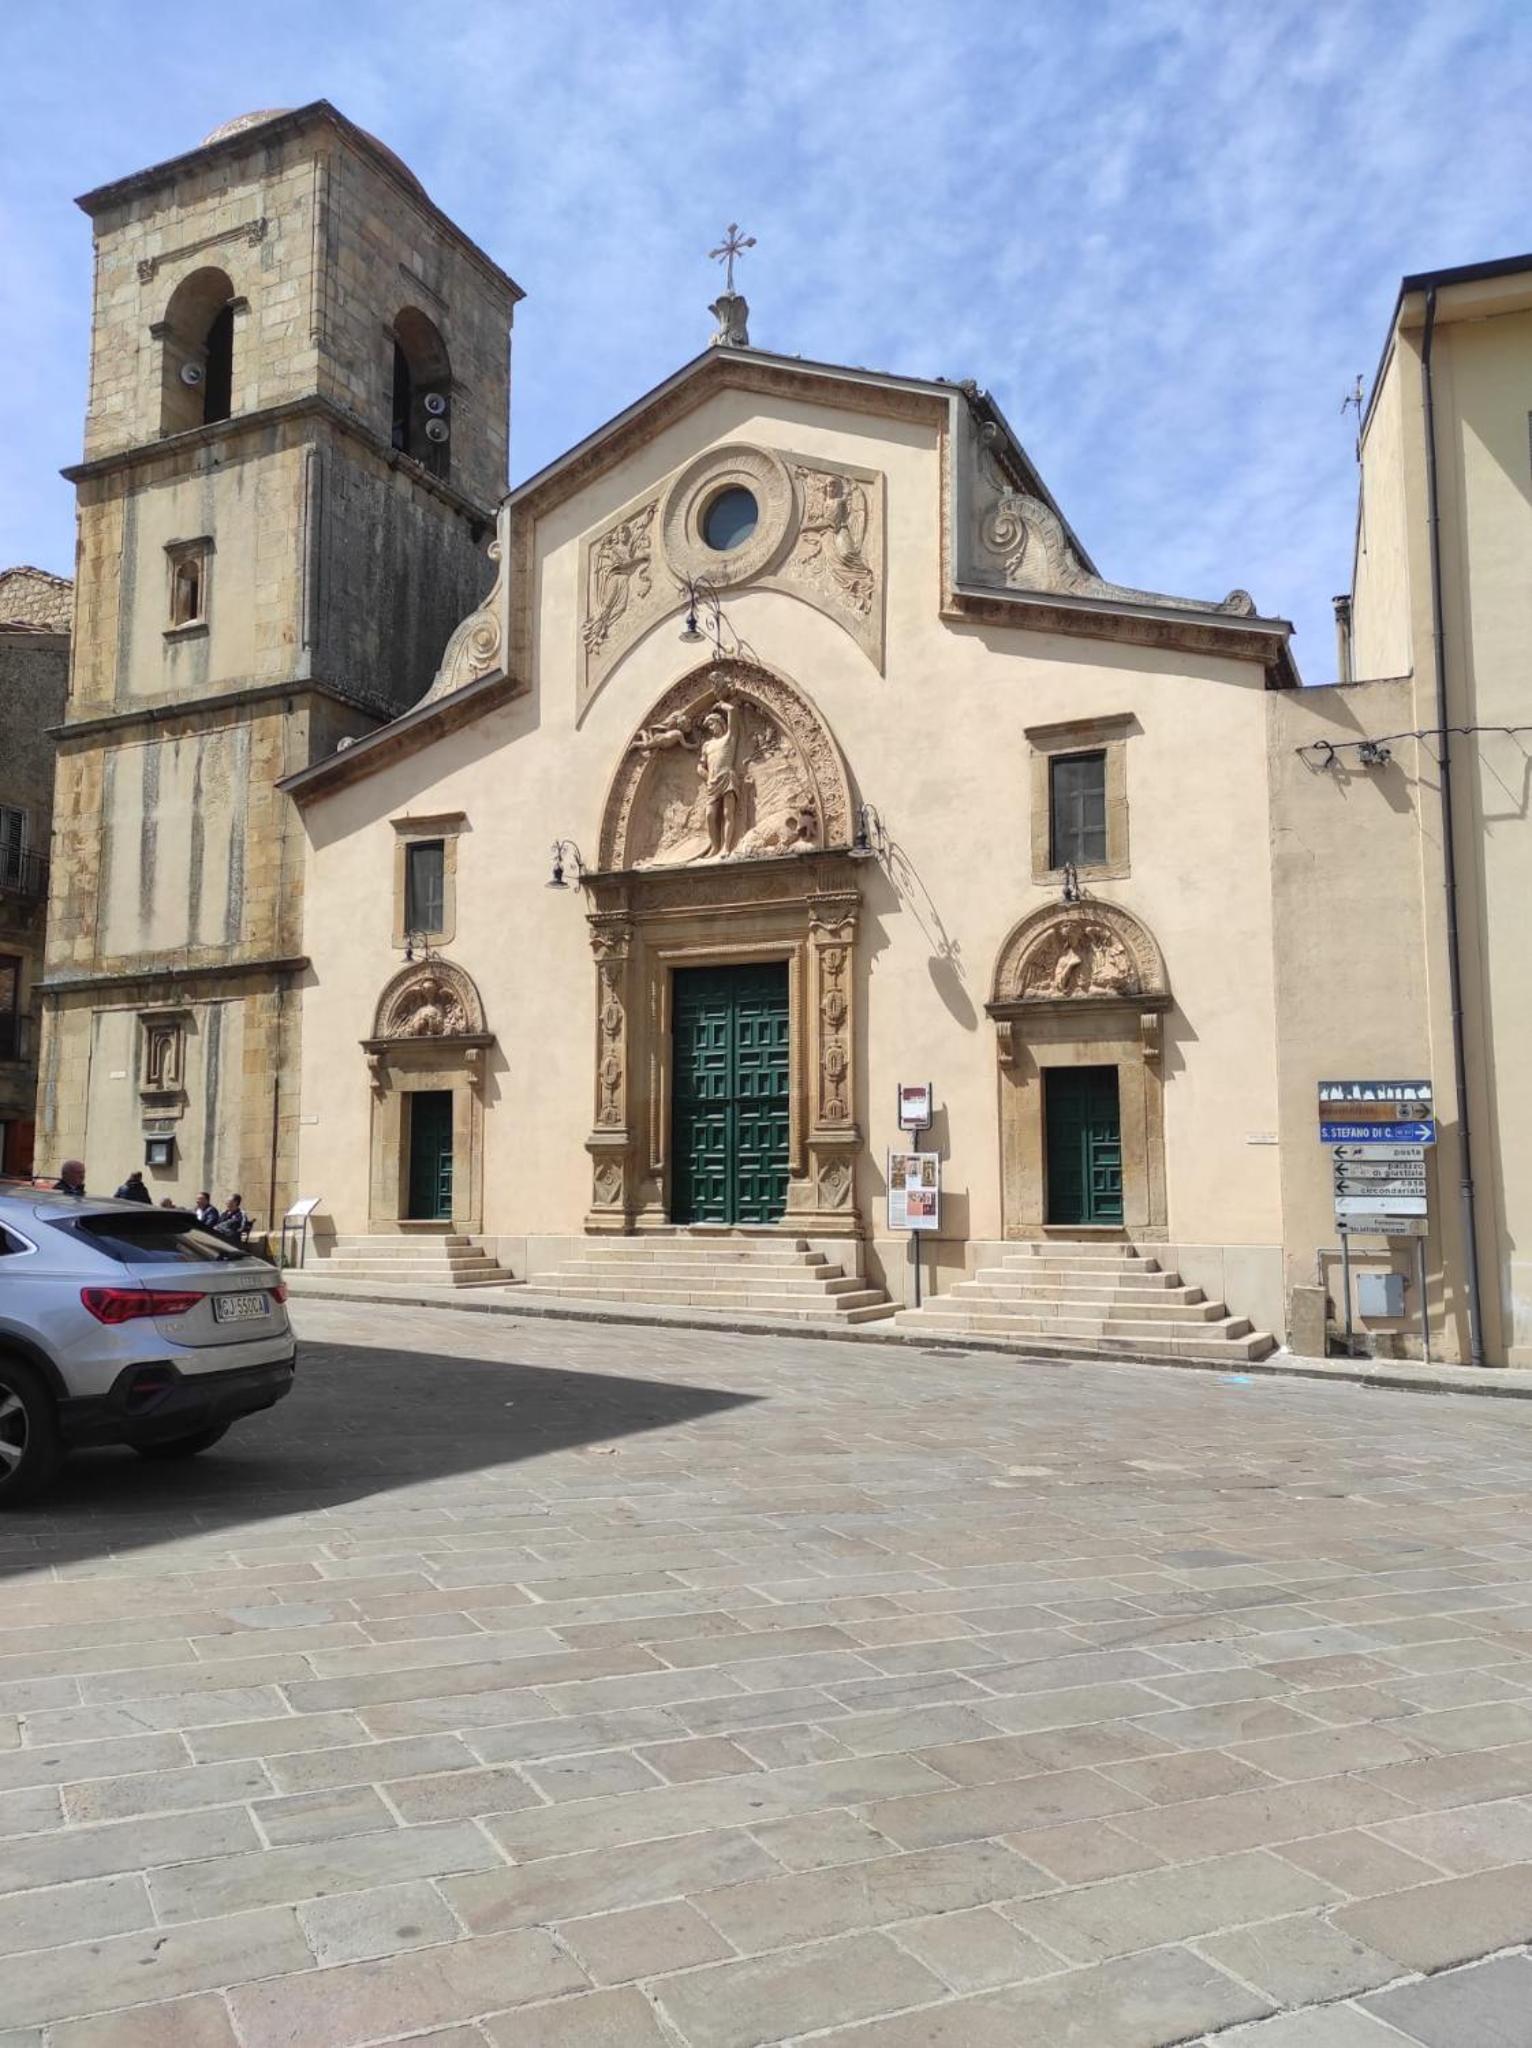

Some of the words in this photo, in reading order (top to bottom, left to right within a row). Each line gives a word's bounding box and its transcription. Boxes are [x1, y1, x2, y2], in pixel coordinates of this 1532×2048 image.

[1321, 1128, 1331, 1138] S.
[1331, 1128, 1369, 1138] STEFANO
[1372, 1128, 1382, 1138] DI
[1385, 1128, 1393, 1138] C.
[1393, 1149, 1421, 1157] posta
[1387, 1162, 1424, 1170] palazzo
[1361, 1186, 1425, 1194] circondariale
